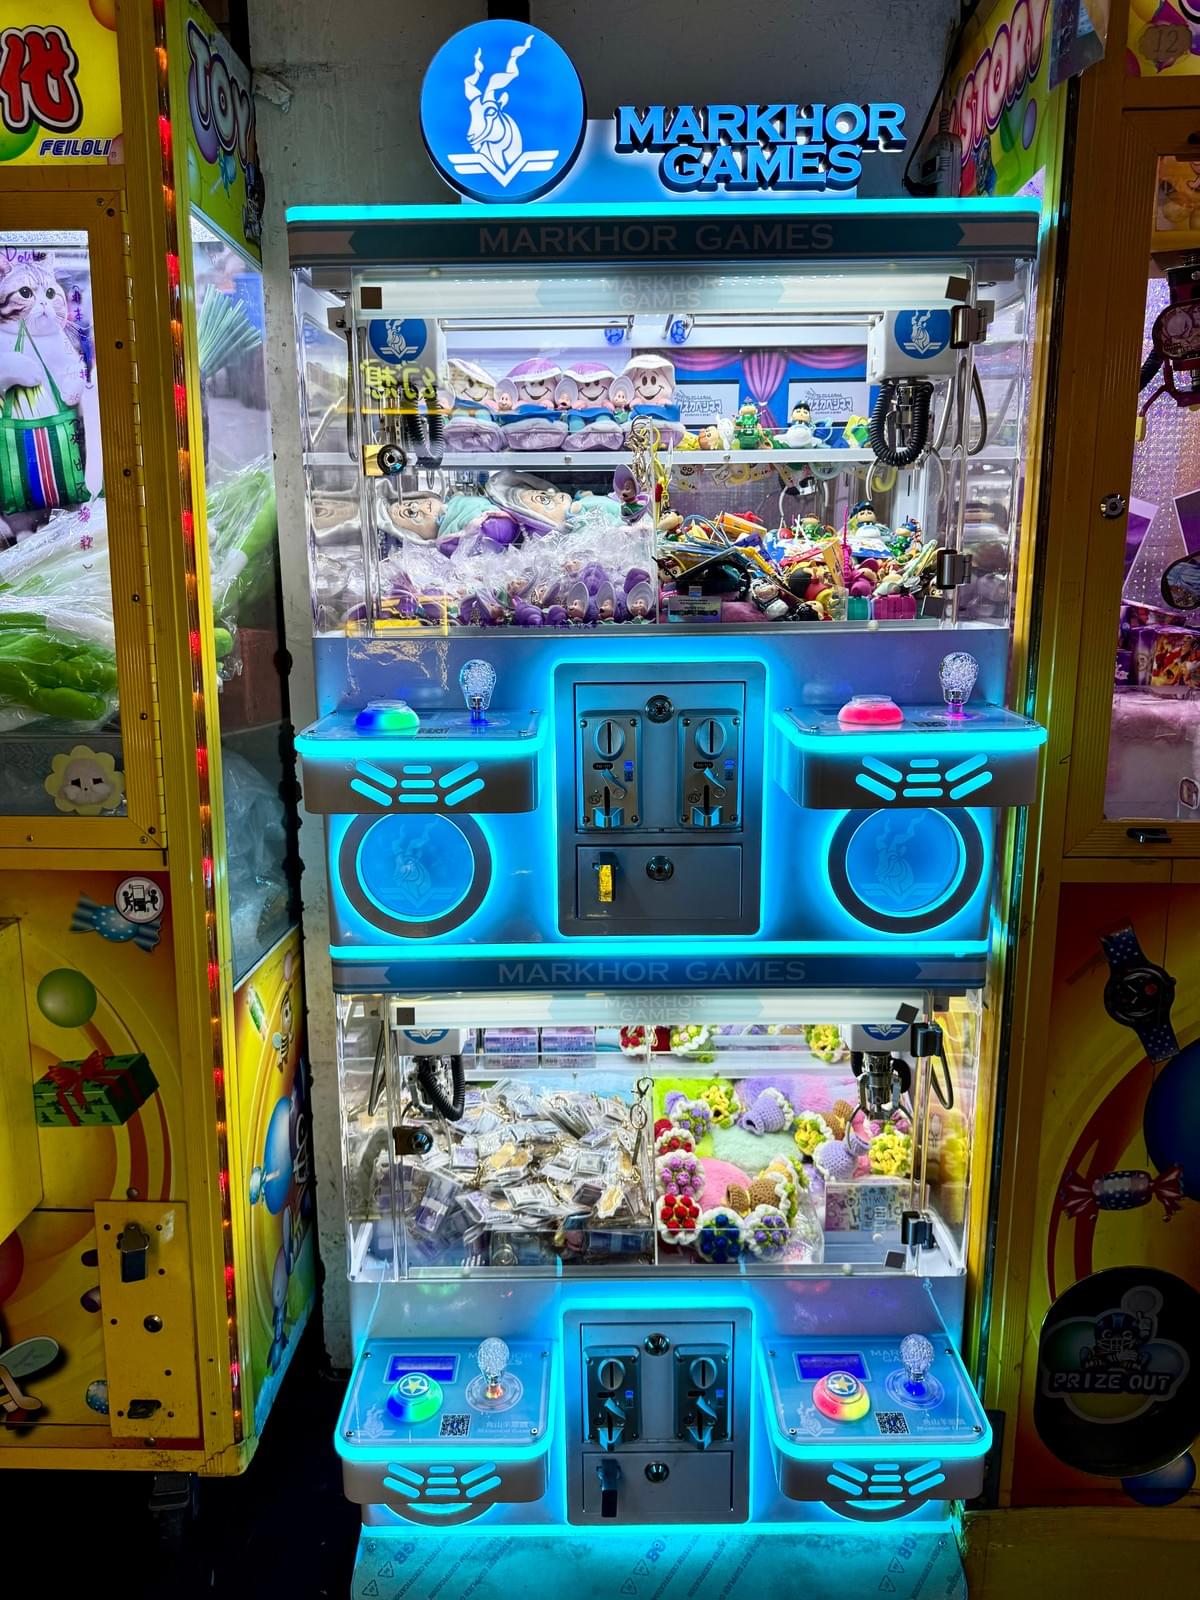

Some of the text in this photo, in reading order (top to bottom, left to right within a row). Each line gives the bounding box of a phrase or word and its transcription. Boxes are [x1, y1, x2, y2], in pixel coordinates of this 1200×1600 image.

[616, 102, 907, 150] MARKHOR
[40, 139, 111, 156] FEILOLI
[661, 143, 863, 189] GAMES
[479, 223, 834, 252] MARKHOR GAMES
[601, 274, 719, 291] MARKHOR
[618, 291, 702, 308] GAMES
[498, 961, 806, 984] MARKHOR GAMES
[619, 1008, 692, 1022] GAMES
[1053, 1372, 1171, 1391] PRIZE OUT
